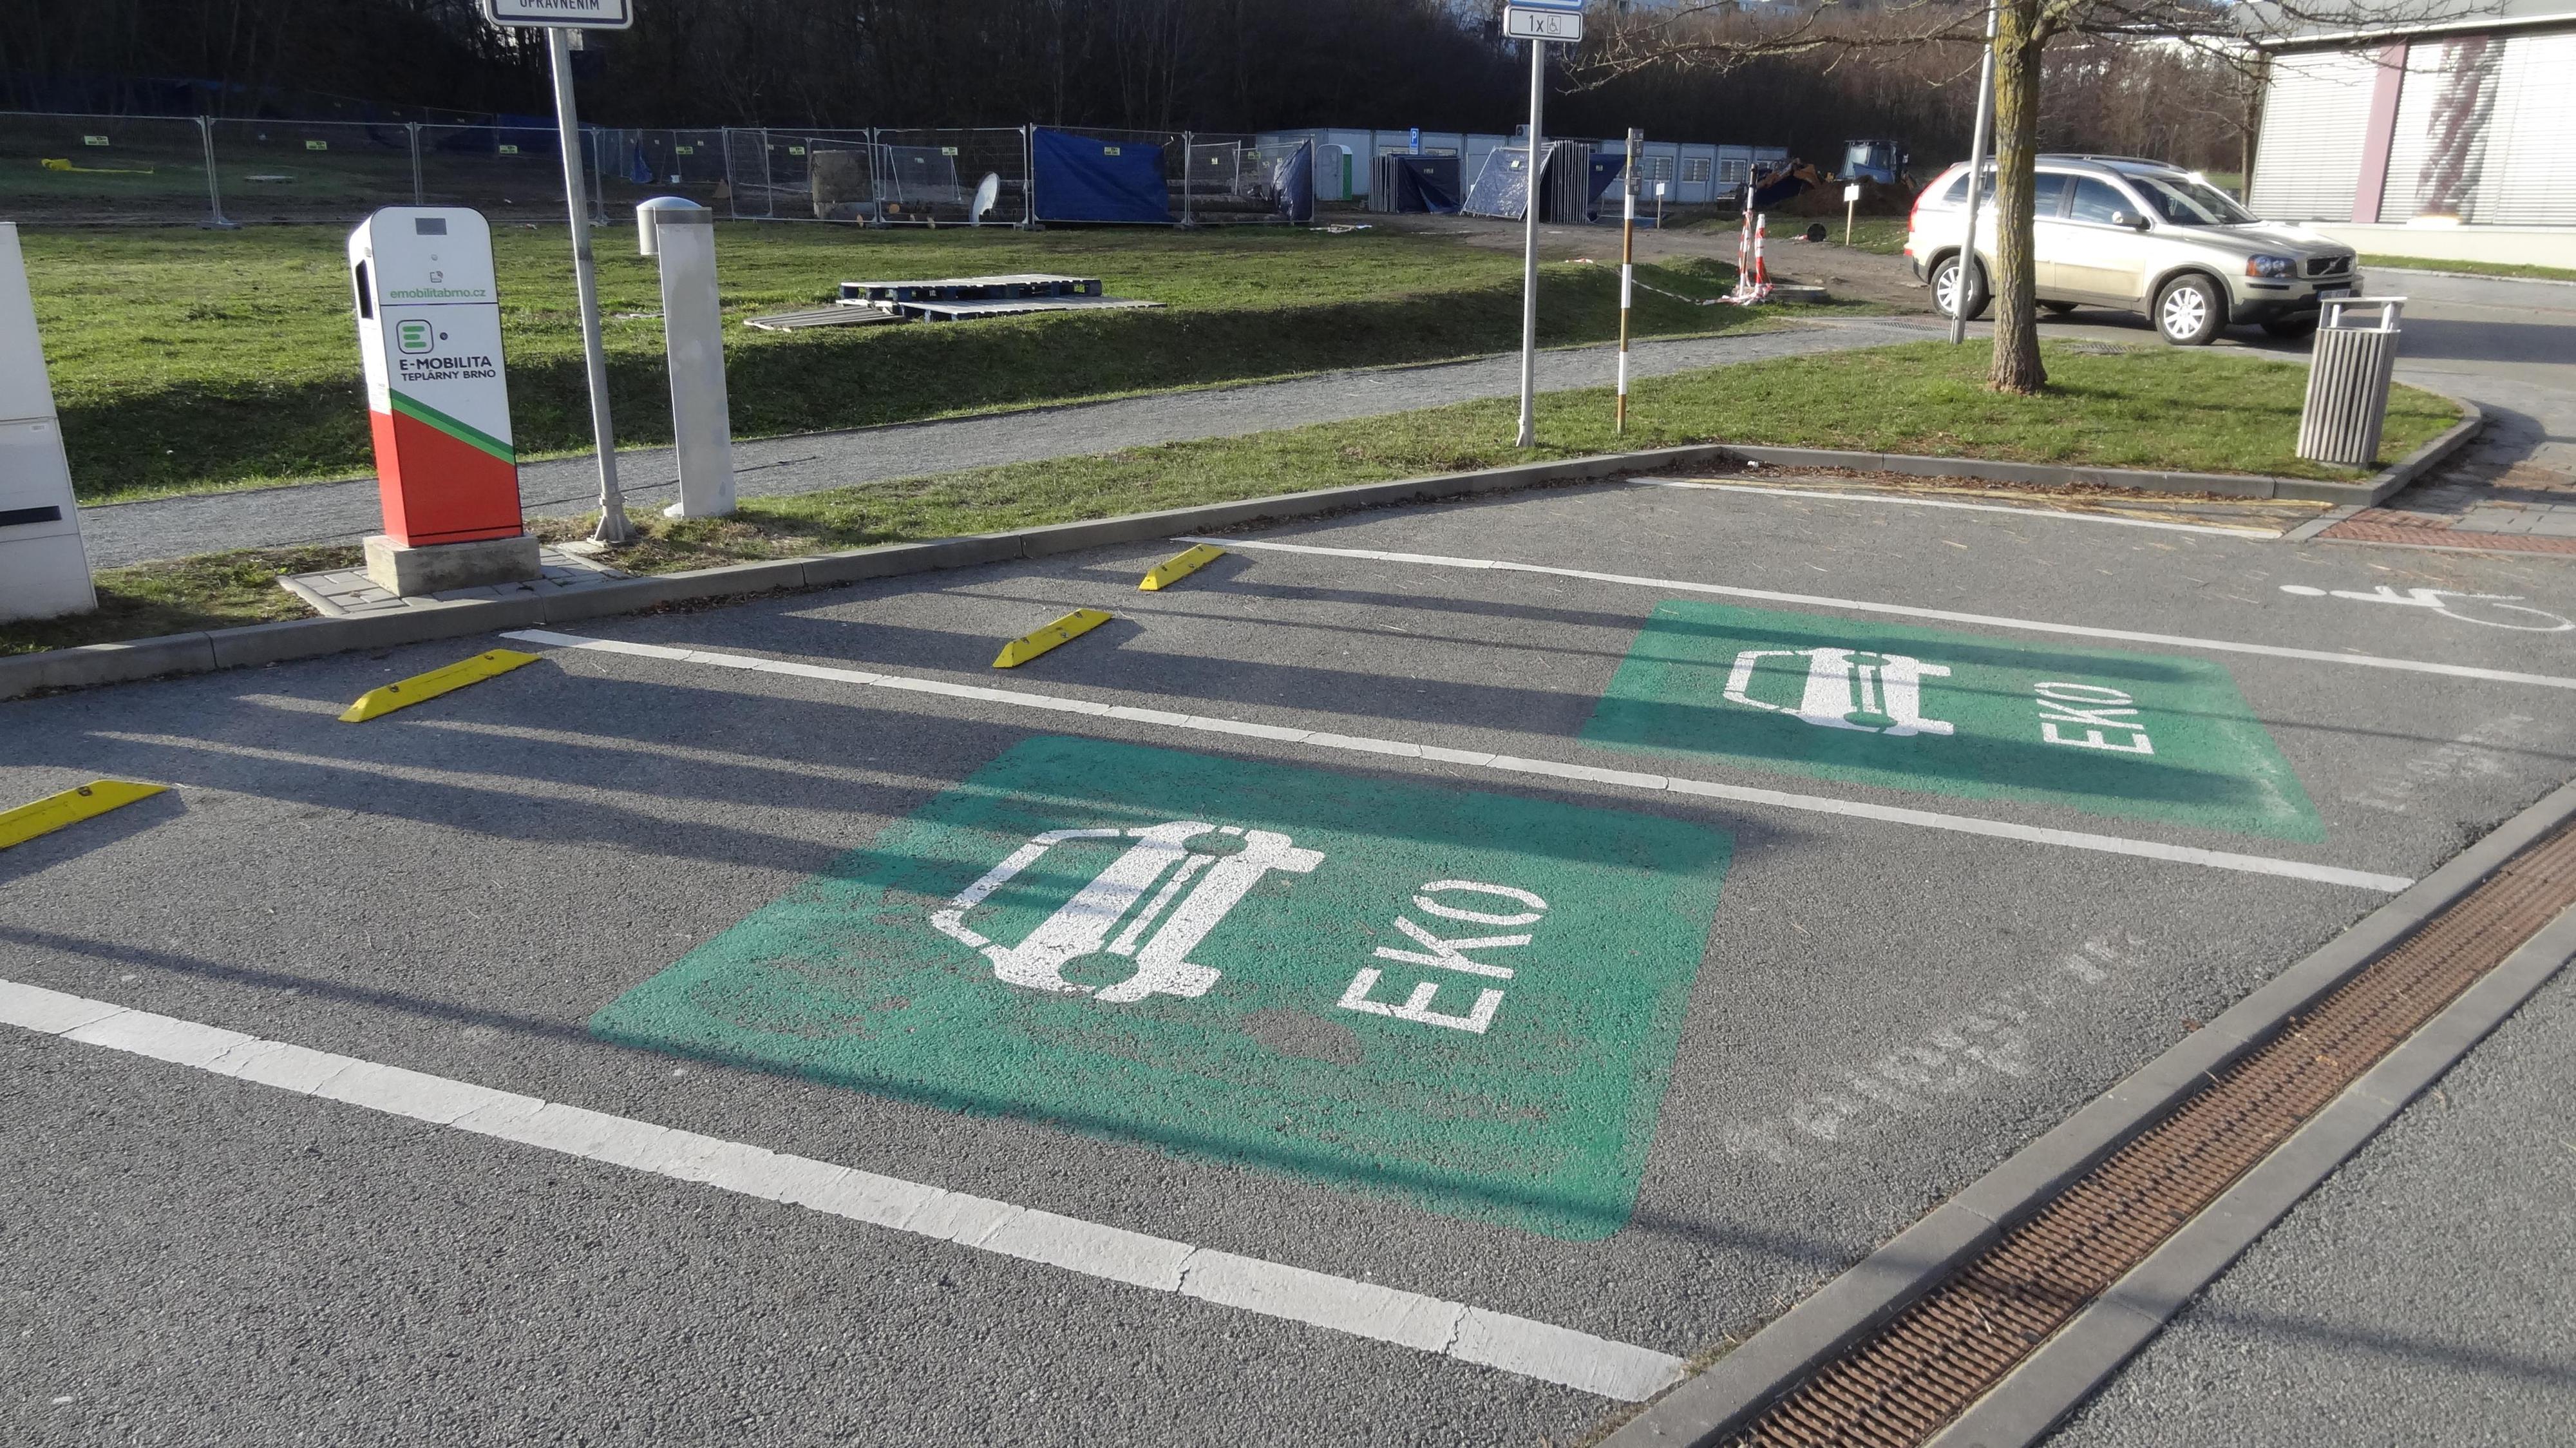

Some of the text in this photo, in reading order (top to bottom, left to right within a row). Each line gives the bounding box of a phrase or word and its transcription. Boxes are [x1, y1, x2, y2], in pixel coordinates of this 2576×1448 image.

[1412, 131, 1417, 143] P
[390, 288, 486, 299] emobilitabrno.cz
[399, 356, 493, 371] E-MOBILITA
[401, 370, 496, 381] TEPLÁRNY BRNO
[2034, 681, 2154, 754] EKO
[1337, 879, 1548, 1033] EKO
